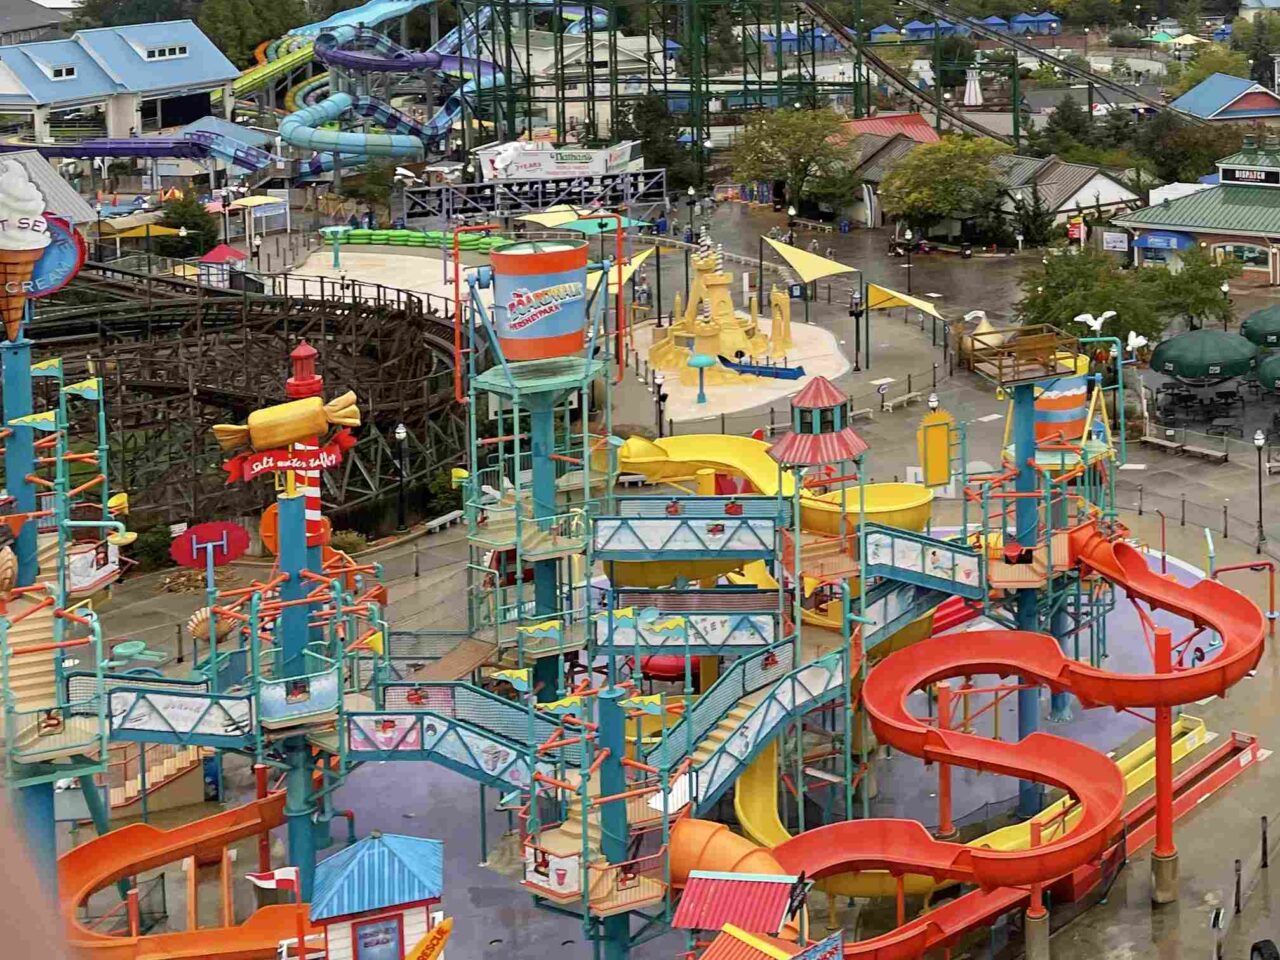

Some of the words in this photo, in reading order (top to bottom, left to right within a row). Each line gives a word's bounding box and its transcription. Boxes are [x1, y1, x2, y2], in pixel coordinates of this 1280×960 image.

[1235, 170, 1266, 180] DISPATCH
[5, 261, 71, 293] CREAM
[509, 304, 562, 331] HERSHEYPARK
